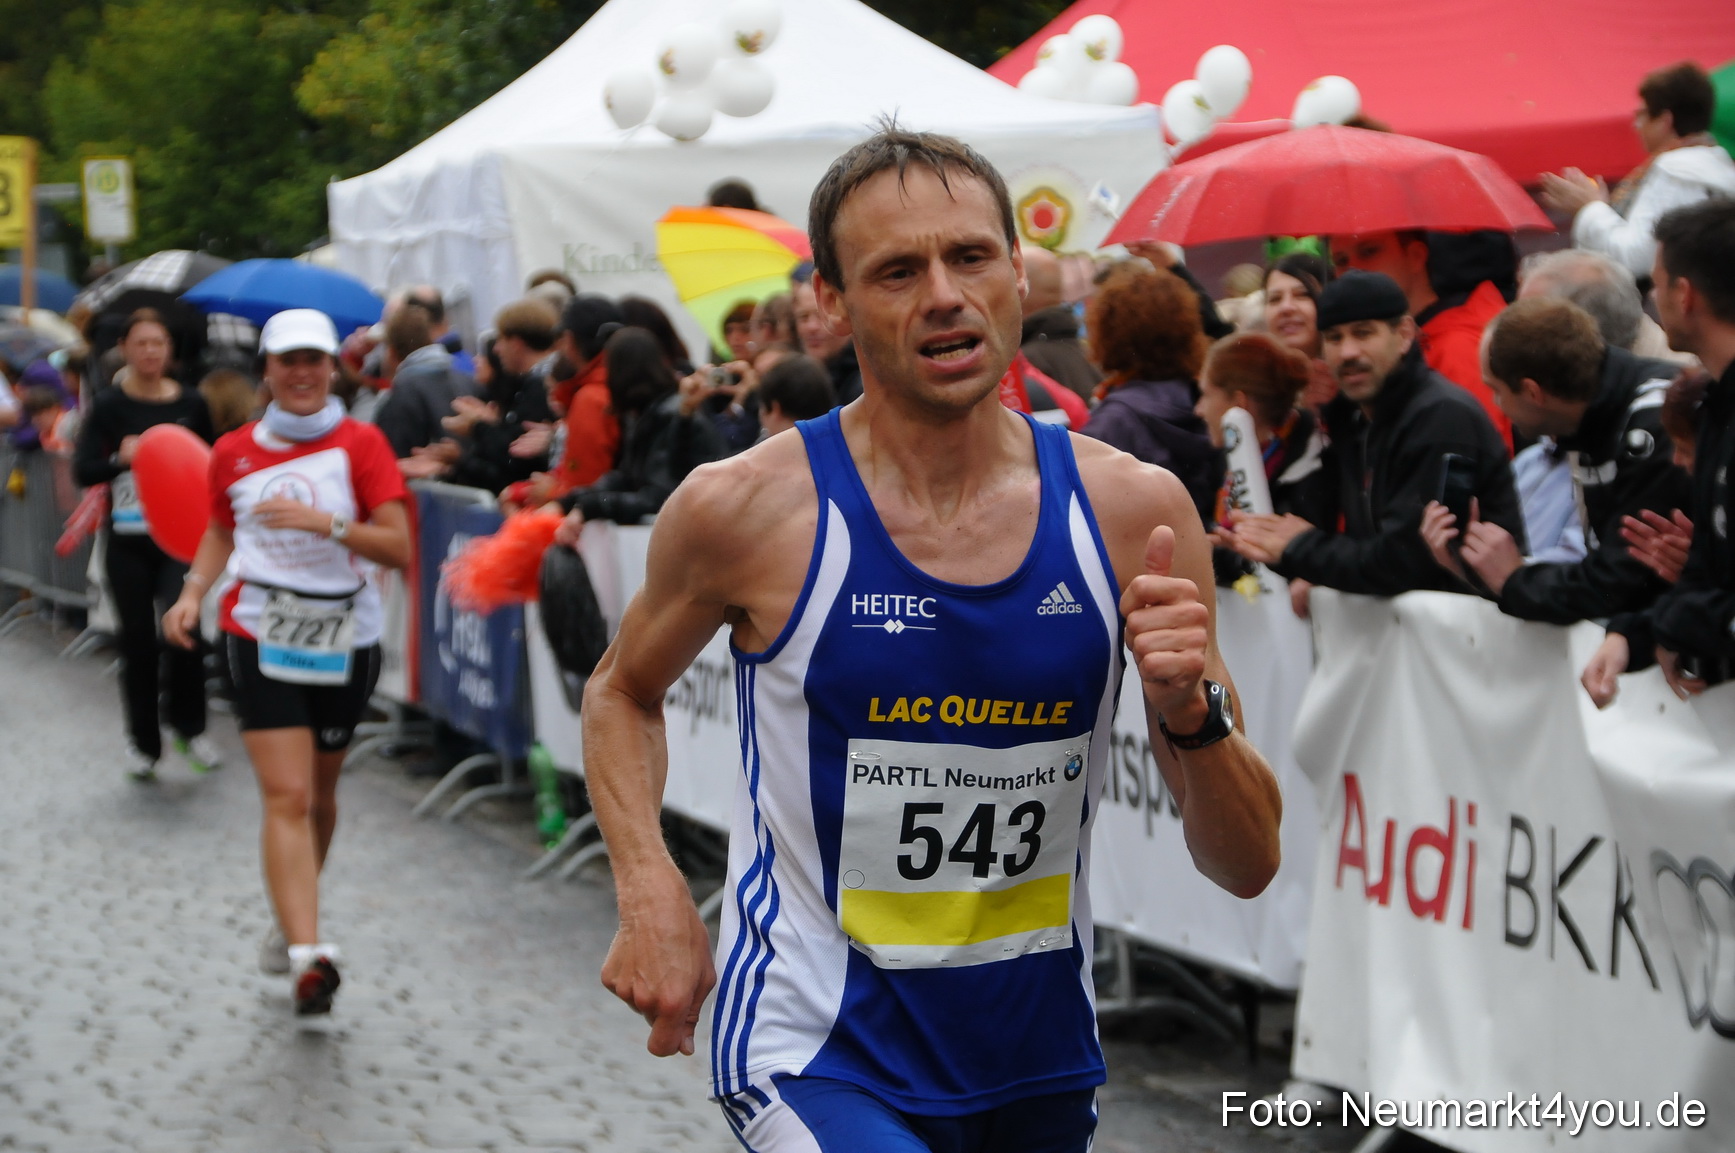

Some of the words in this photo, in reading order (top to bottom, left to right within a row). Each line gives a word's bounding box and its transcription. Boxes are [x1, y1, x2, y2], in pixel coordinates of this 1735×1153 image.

[563, 242, 666, 275] Kinde
[852, 594, 937, 618] HEITEC
[1036, 601, 1083, 616] adidas
[267, 611, 344, 647] 2727
[868, 696, 934, 724] LAC
[939, 695, 1074, 727] QUELLE
[852, 764, 938, 788] PARTL
[944, 766, 1056, 791] Neumarkt
[896, 799, 1047, 881] 543
[1335, 772, 1478, 932] Audi
[1504, 811, 1662, 994] BKK
